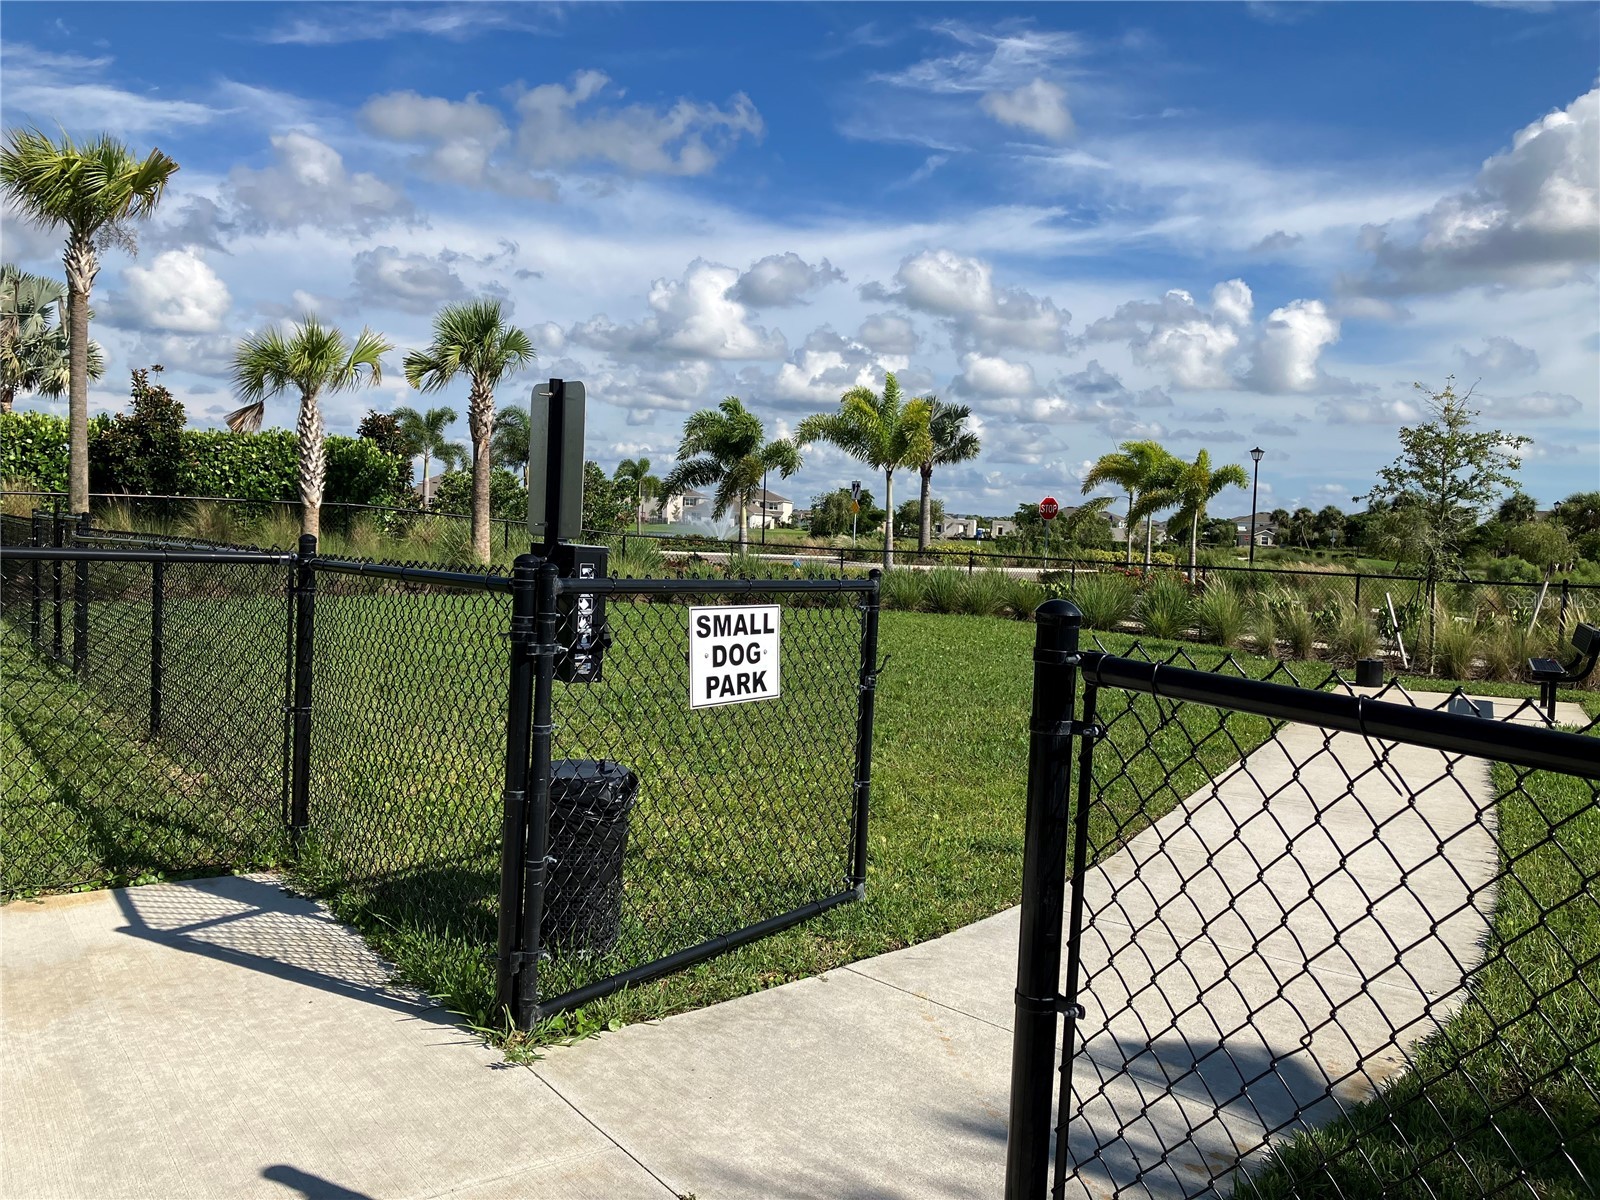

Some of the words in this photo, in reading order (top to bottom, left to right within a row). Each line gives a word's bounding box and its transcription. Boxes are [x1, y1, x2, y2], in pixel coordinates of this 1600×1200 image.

[1040, 504, 1058, 513] STOP
[696, 613, 775, 638] SMALL
[712, 642, 761, 668] DOG
[706, 670, 768, 699] PARK
